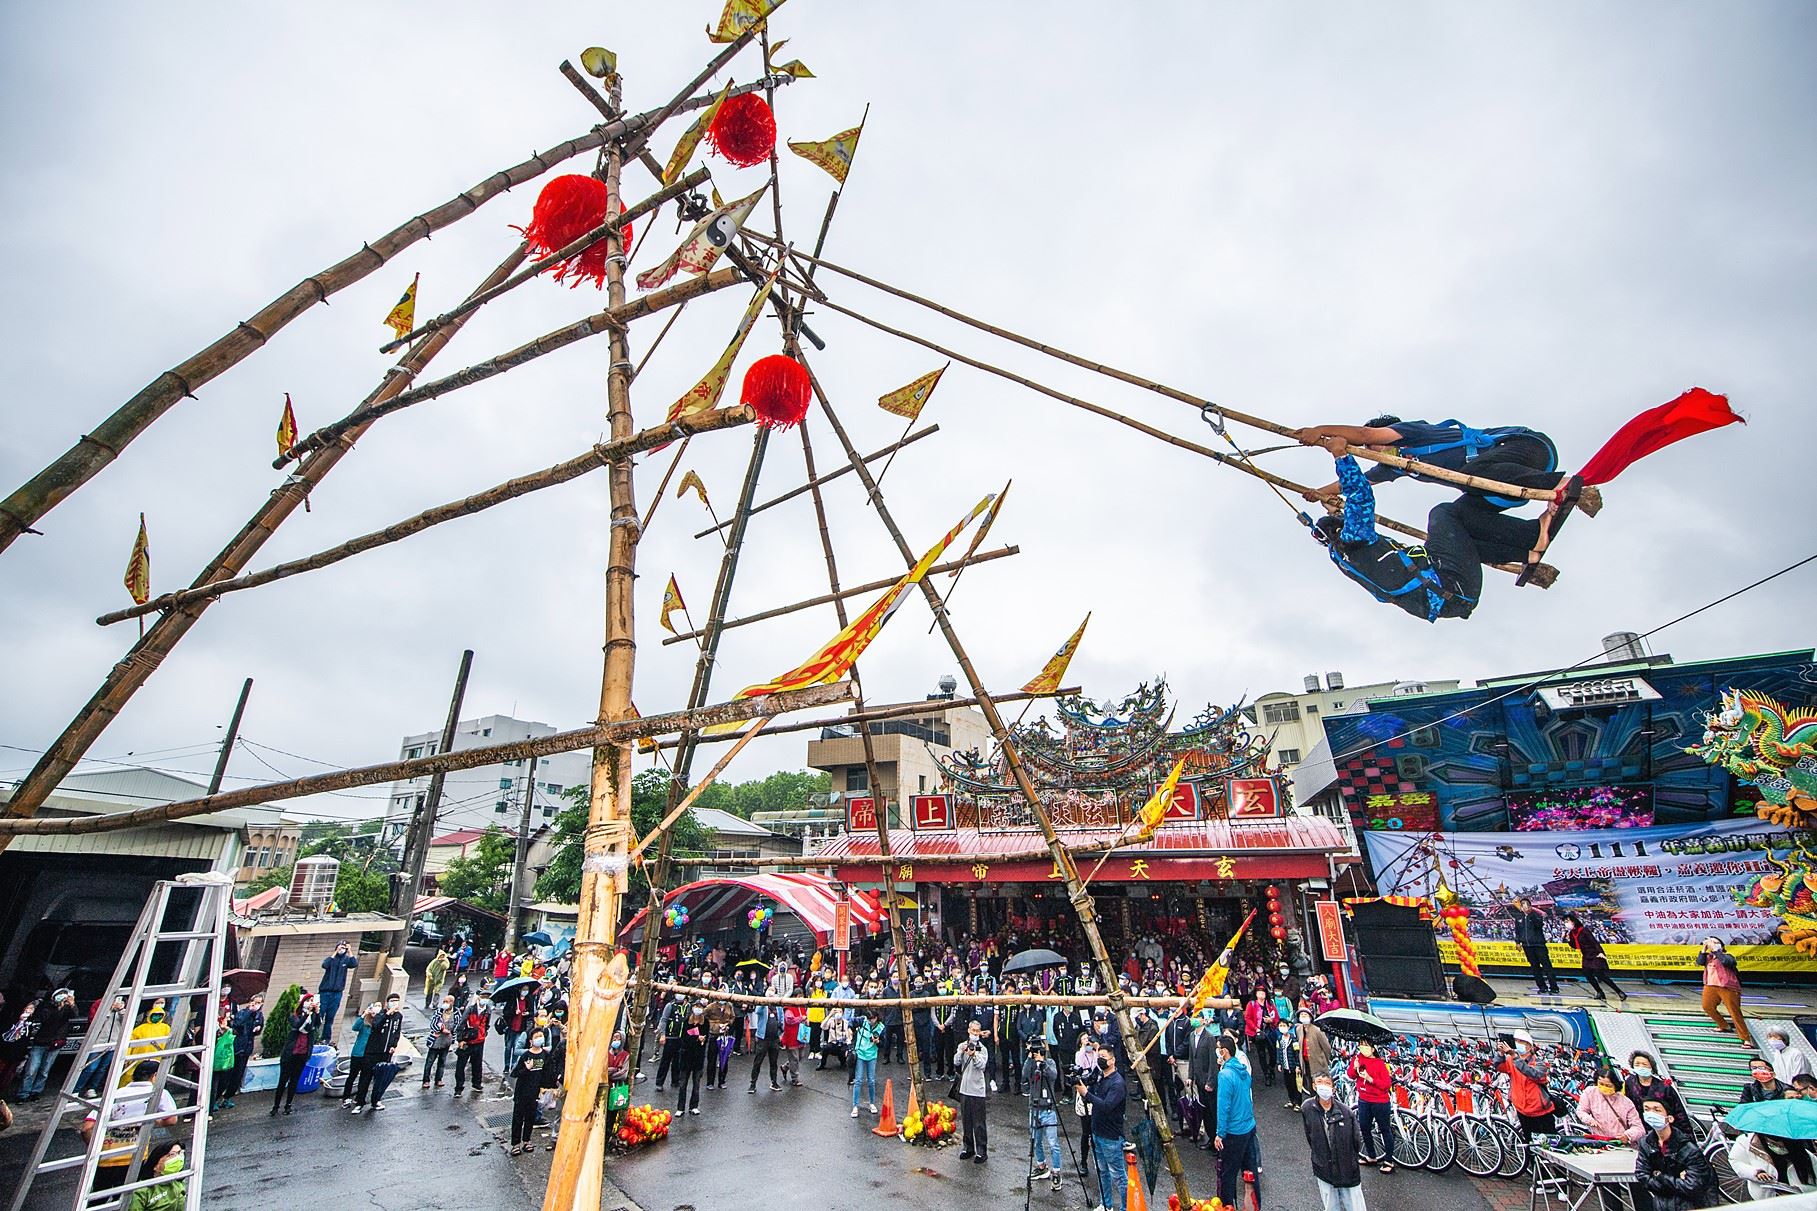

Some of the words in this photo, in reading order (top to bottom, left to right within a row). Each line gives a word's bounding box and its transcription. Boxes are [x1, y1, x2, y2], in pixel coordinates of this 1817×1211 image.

[1236, 782, 1268, 812] 玄
[855, 801, 875, 826] 帝
[920, 799, 944, 824] 上
[1588, 840, 1652, 859] 111
[1323, 908, 1340, 954] 入廟大吉
